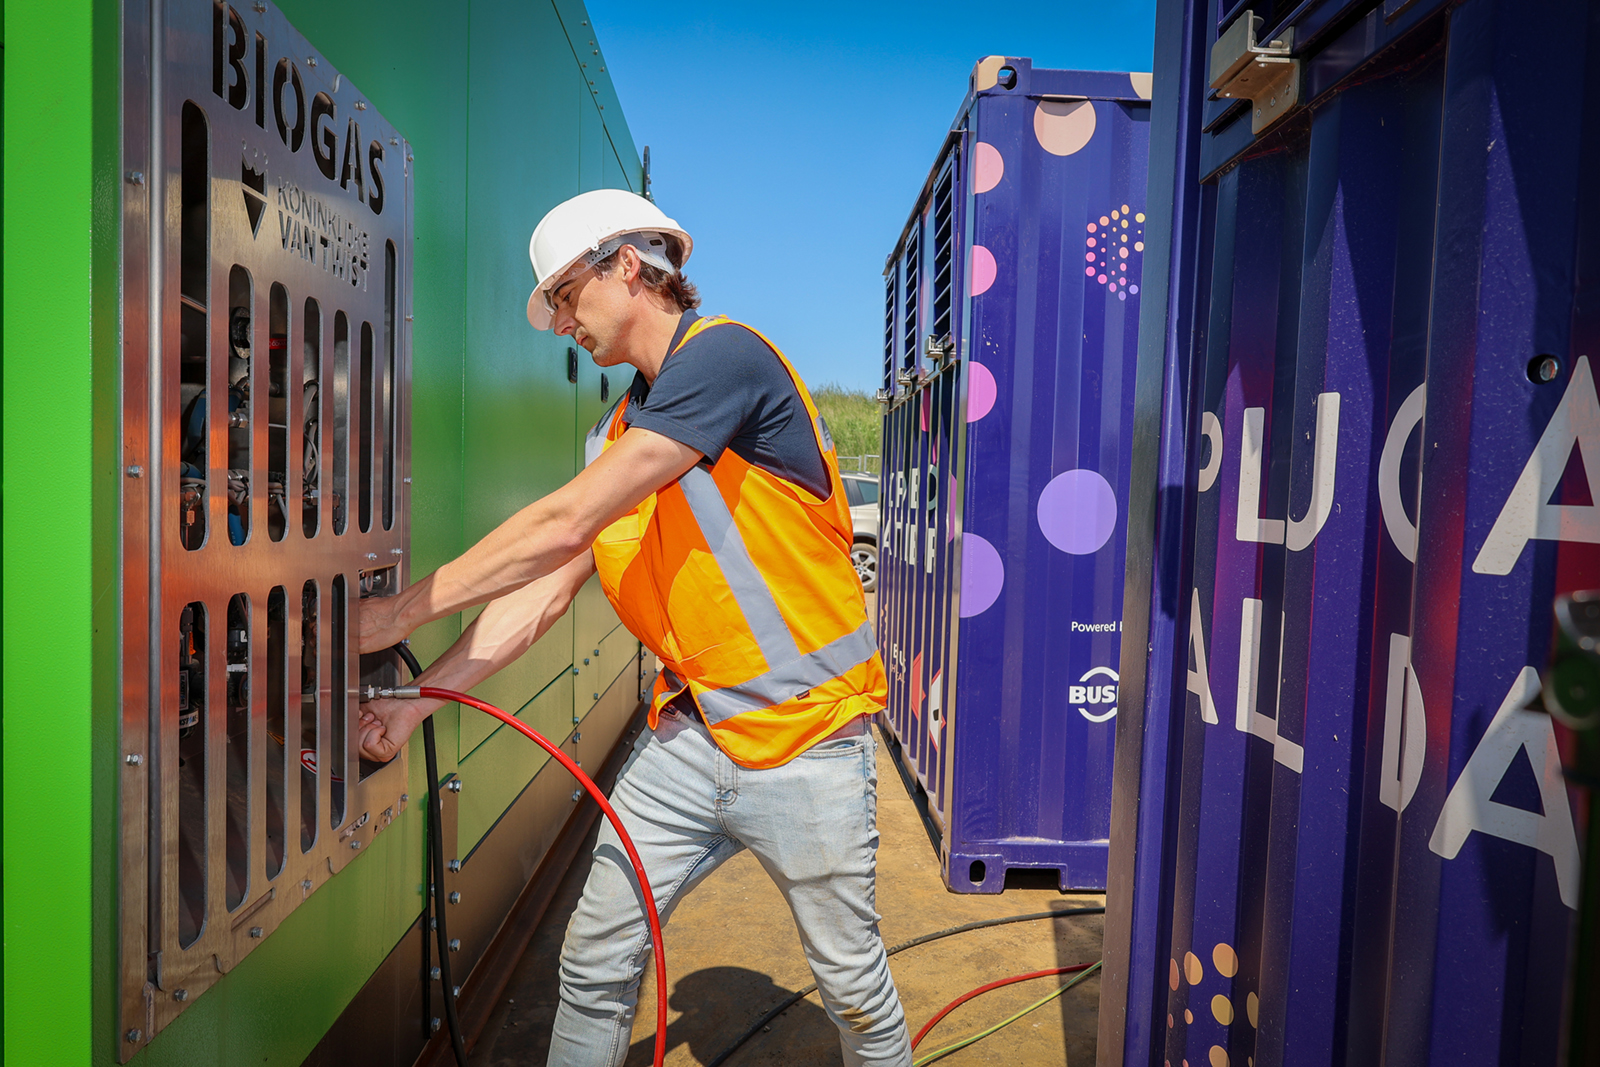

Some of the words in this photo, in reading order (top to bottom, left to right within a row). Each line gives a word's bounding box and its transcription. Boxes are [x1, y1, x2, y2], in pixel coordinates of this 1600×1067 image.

[212, 0, 385, 215] BIOGAS
[278, 209, 316, 266] VAN
[320, 235, 369, 292] TWIST
[1071, 620, 1116, 632] Powered
[1068, 685, 1119, 704] BUS
